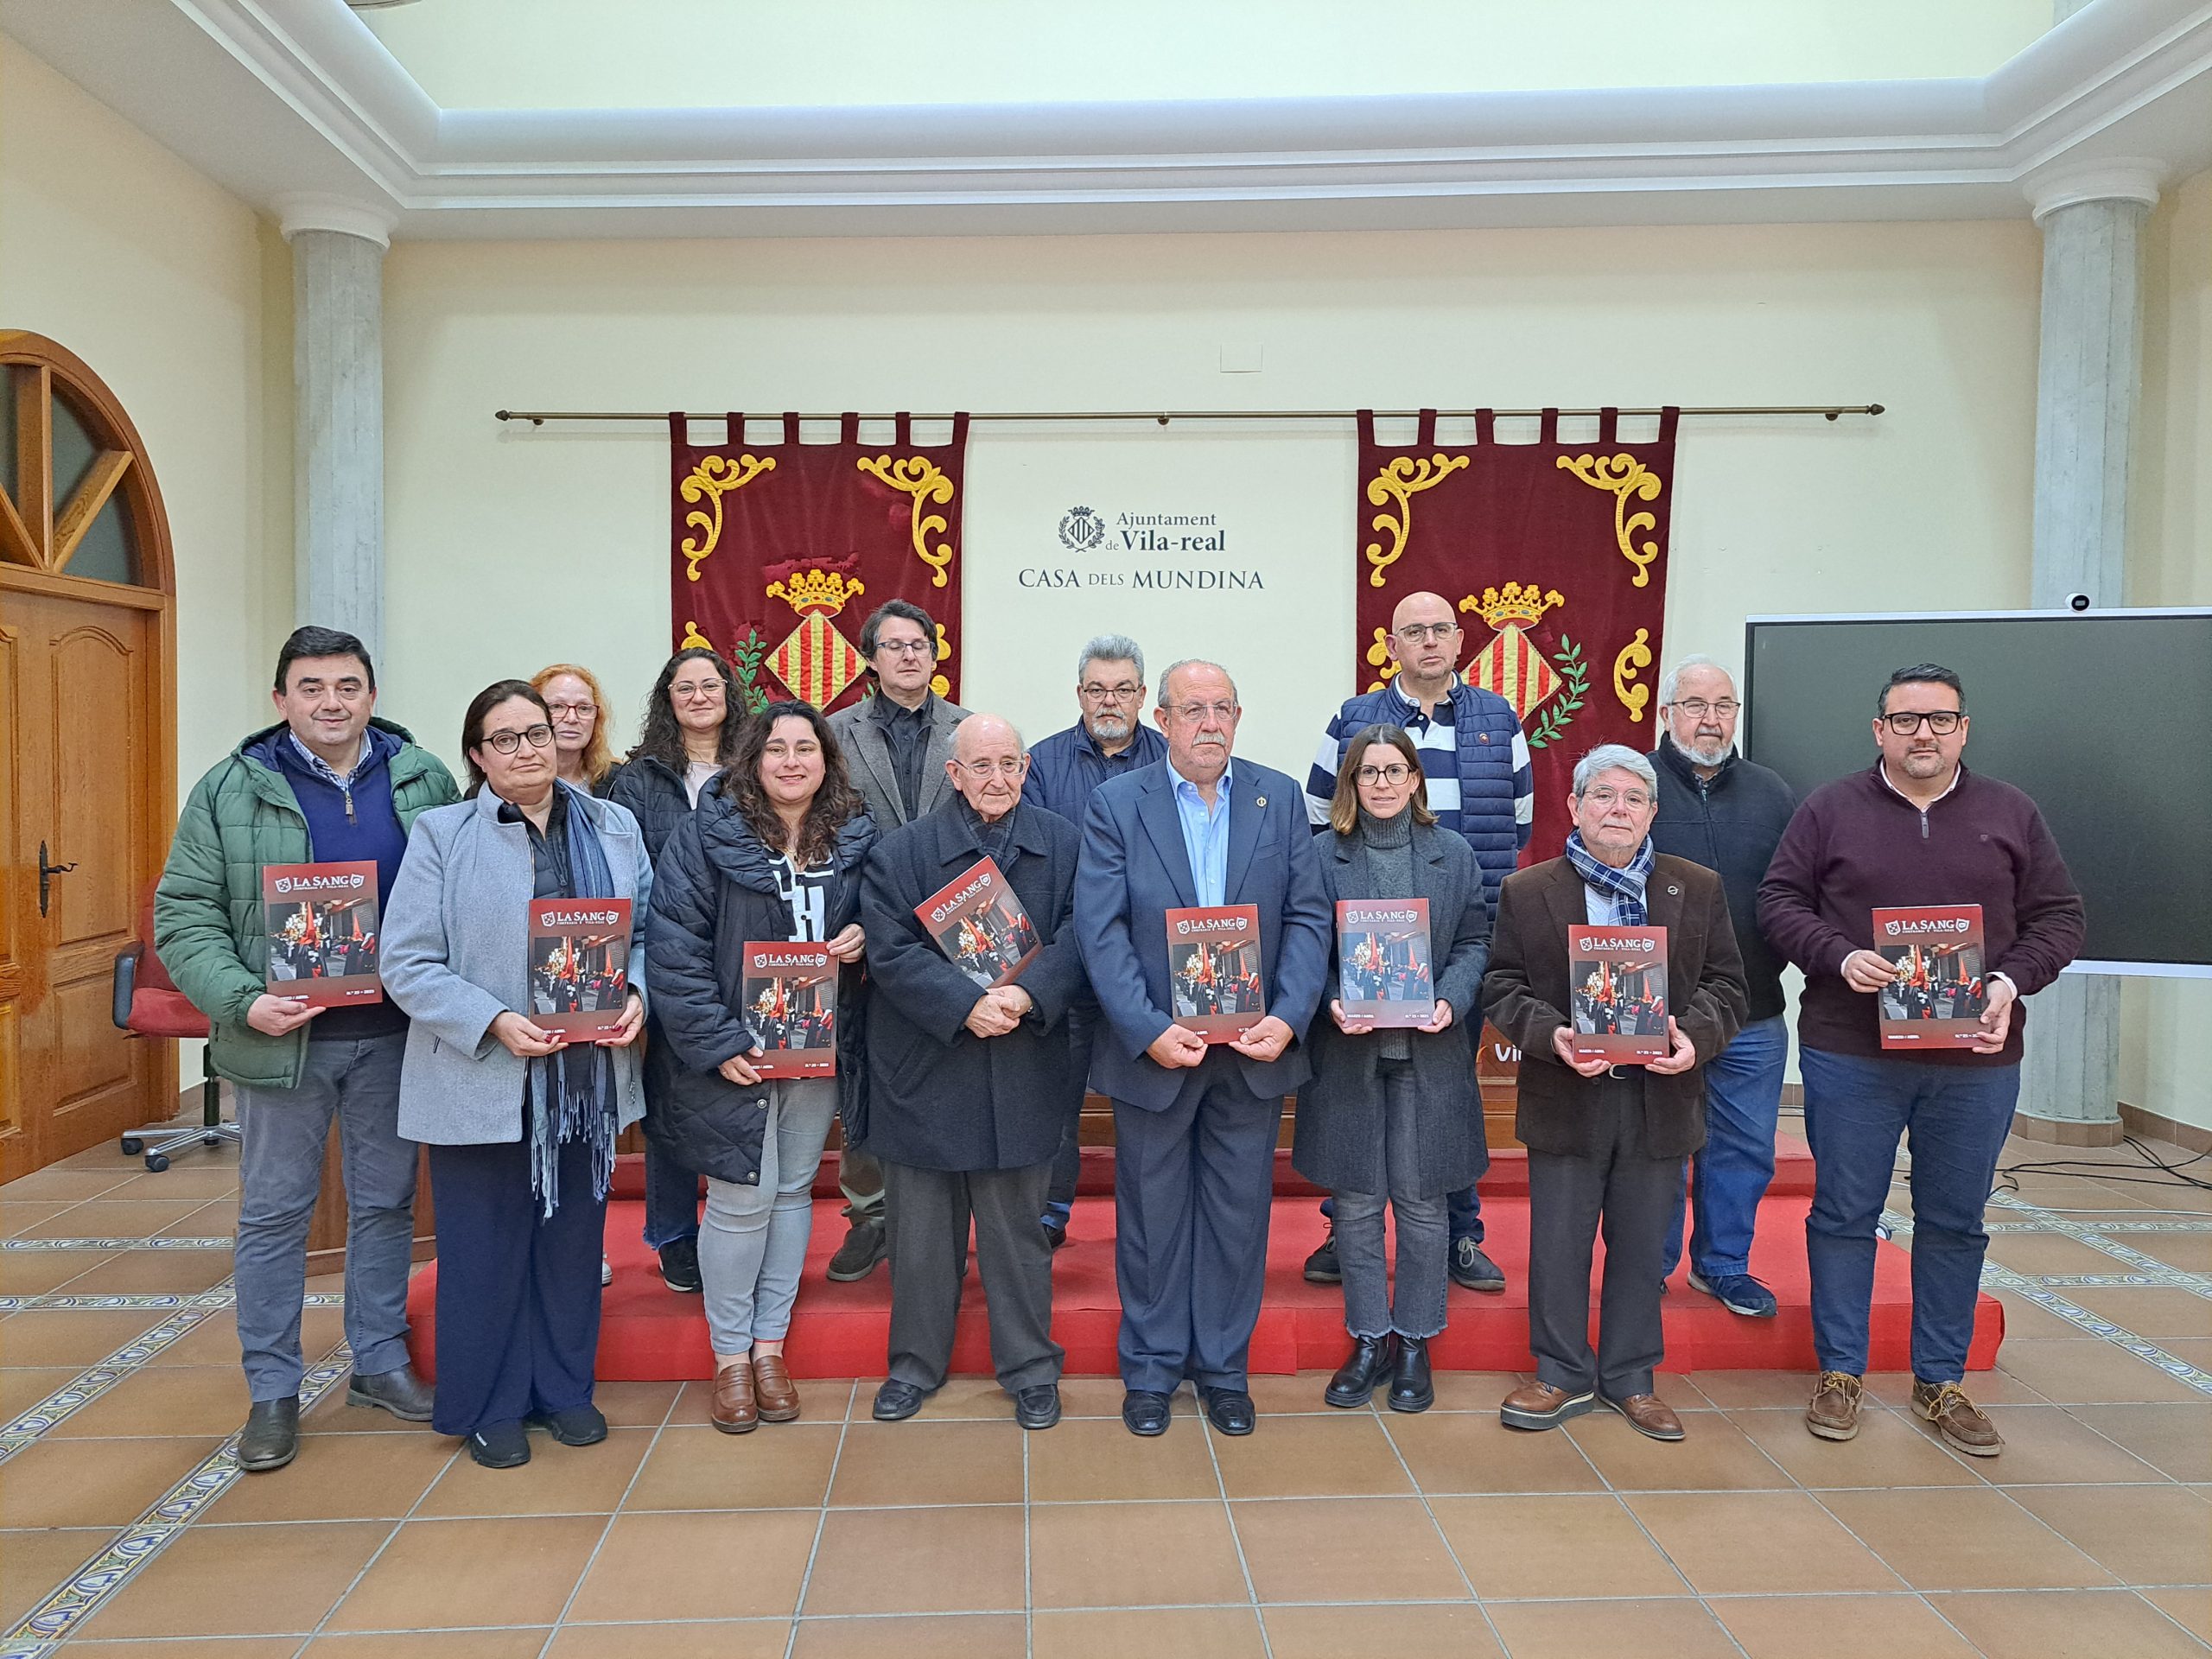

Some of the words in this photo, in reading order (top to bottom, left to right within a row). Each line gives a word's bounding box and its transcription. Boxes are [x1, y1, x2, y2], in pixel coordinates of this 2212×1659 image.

[1116, 512, 1217, 530] Ajuntament
[1105, 539, 1120, 551] de
[1120, 529, 1226, 552] Vila-real
[1018, 568, 1083, 588] CASA
[1088, 572, 1125, 587] DELS
[1132, 569, 1266, 590] MUNDINA
[293, 876, 311, 887] LA
[312, 875, 349, 887] SANG
[941, 899, 958, 912] LA
[955, 880, 982, 902] SANG
[556, 912, 572, 922] LA
[573, 911, 605, 922] SANG
[1359, 911, 1375, 919] LA
[1376, 910, 1405, 919] SANG
[1190, 919, 1205, 929] LA
[1206, 918, 1236, 928] SANG
[1901, 920, 1918, 931] LA
[1919, 919, 1955, 930] SANG
[1593, 937, 1608, 947] LA
[1609, 938, 1642, 948] SANG
[768, 953, 784, 963] LA
[785, 953, 815, 963] SANG
